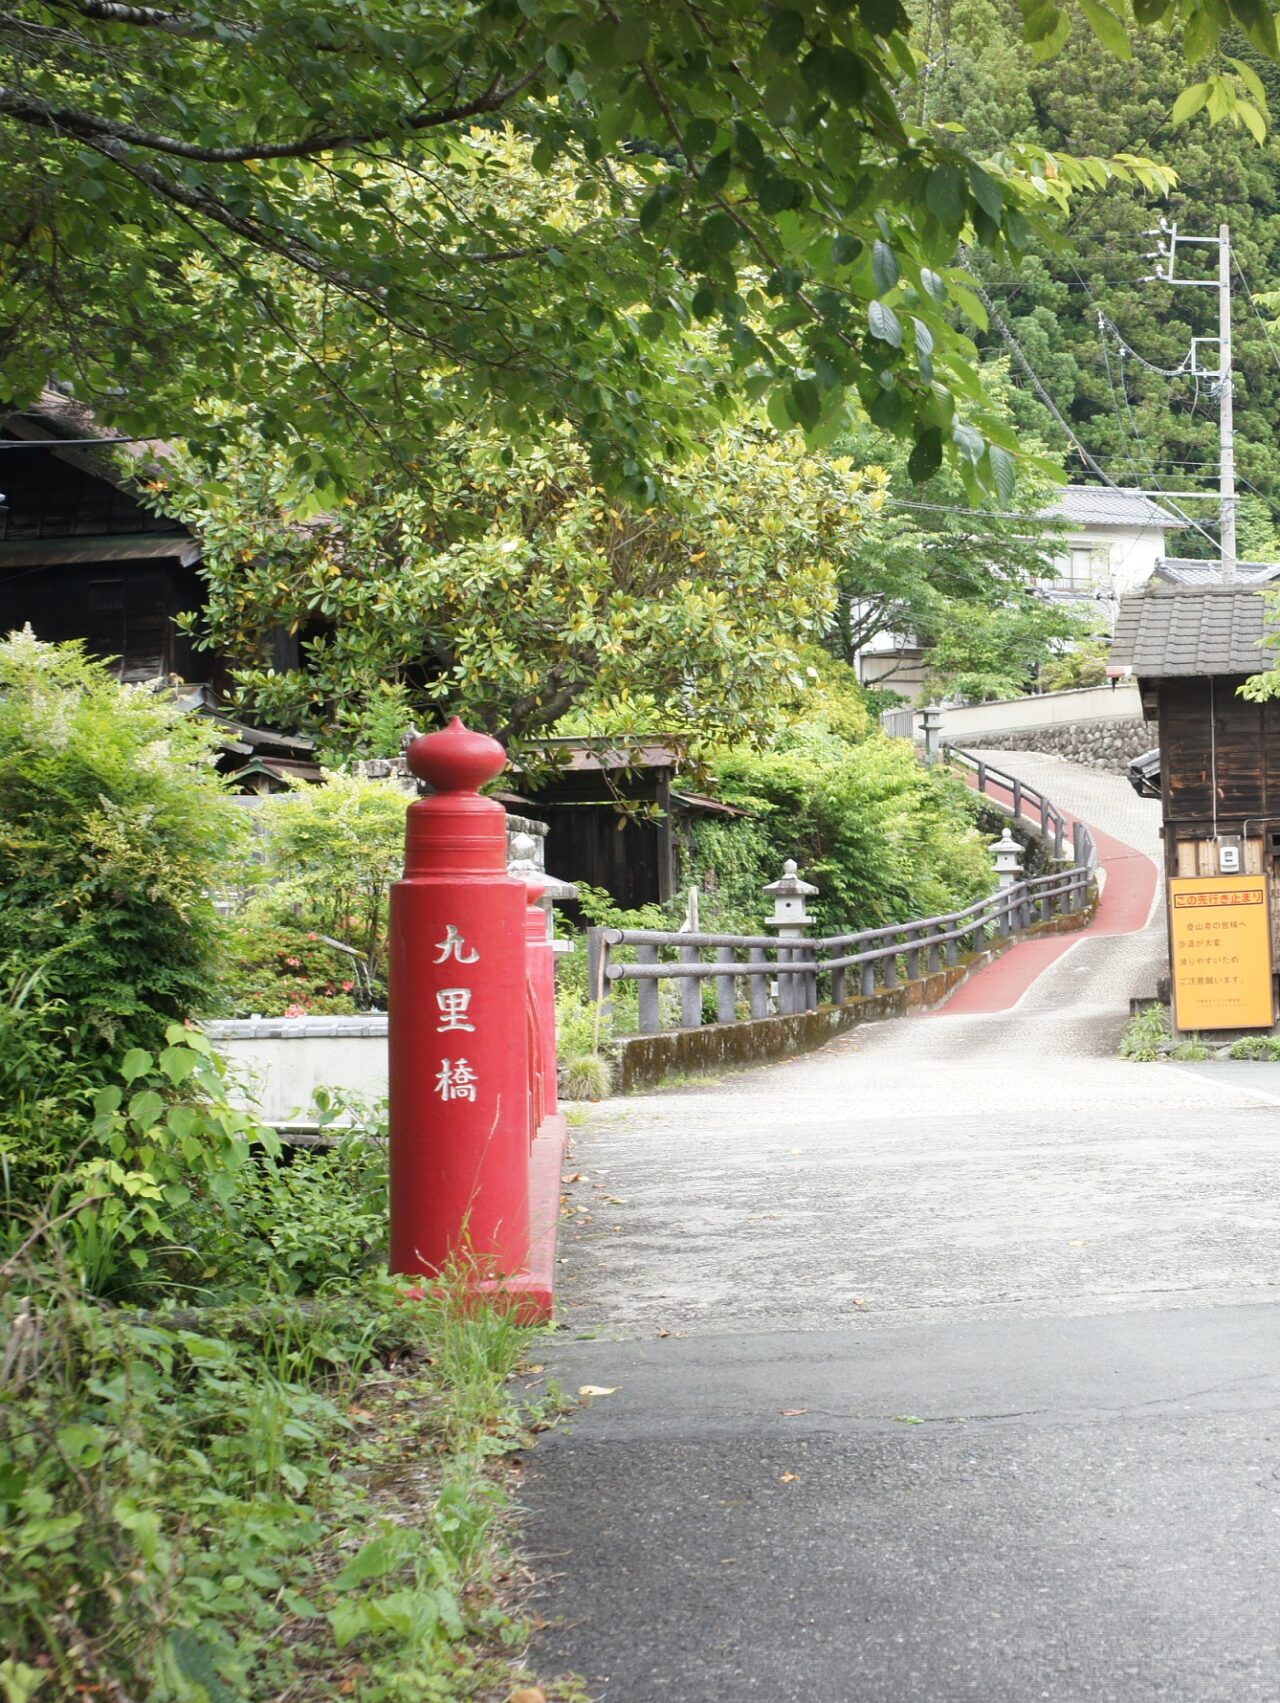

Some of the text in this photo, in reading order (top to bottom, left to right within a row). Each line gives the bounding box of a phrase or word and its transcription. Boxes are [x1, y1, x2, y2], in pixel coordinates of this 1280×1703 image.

[1176, 892, 1262, 906] この先行き止まり
[1186, 921, 1248, 931] 登山者の皆様へ
[1178, 938, 1222, 949] 歩道が大変
[1179, 955, 1240, 966] 滑りやすいため
[432, 924, 480, 1103] 九里橋
